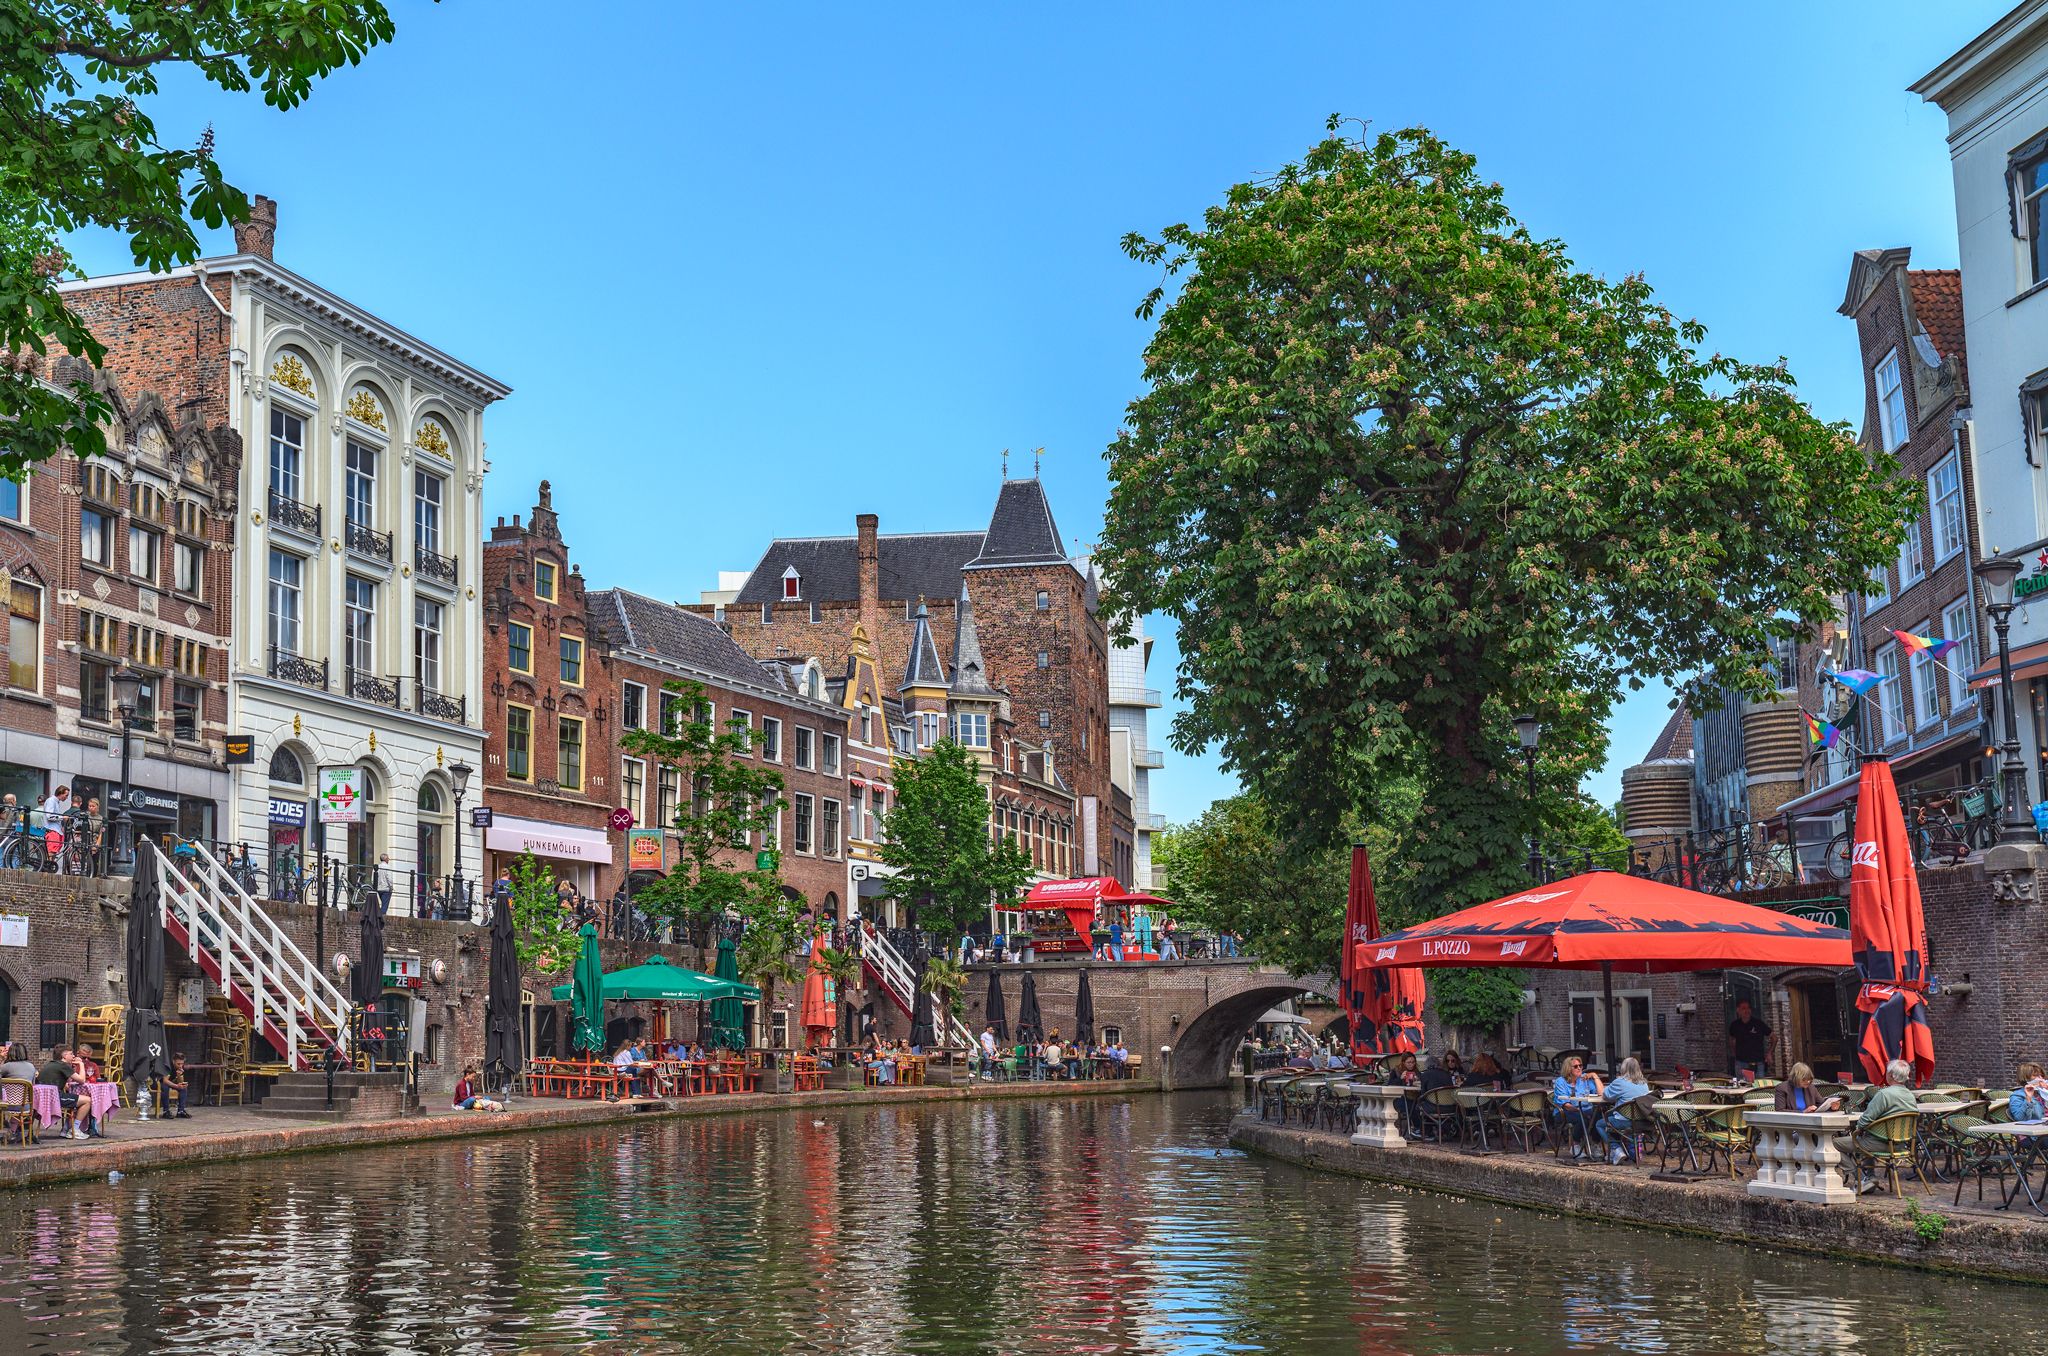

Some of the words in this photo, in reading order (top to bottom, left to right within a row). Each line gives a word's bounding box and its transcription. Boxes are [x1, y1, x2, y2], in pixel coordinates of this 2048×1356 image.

[2014, 573, 2048, 597] Hein
[488, 753, 500, 765] 111
[592, 775, 604, 786] 111
[109, 790, 133, 802] JUT
[145, 796, 179, 809] BRANDS
[523, 839, 582, 855] HUNKEMÖLLER
[1422, 941, 1434, 956] IL
[1434, 940, 1471, 956] POZZO
